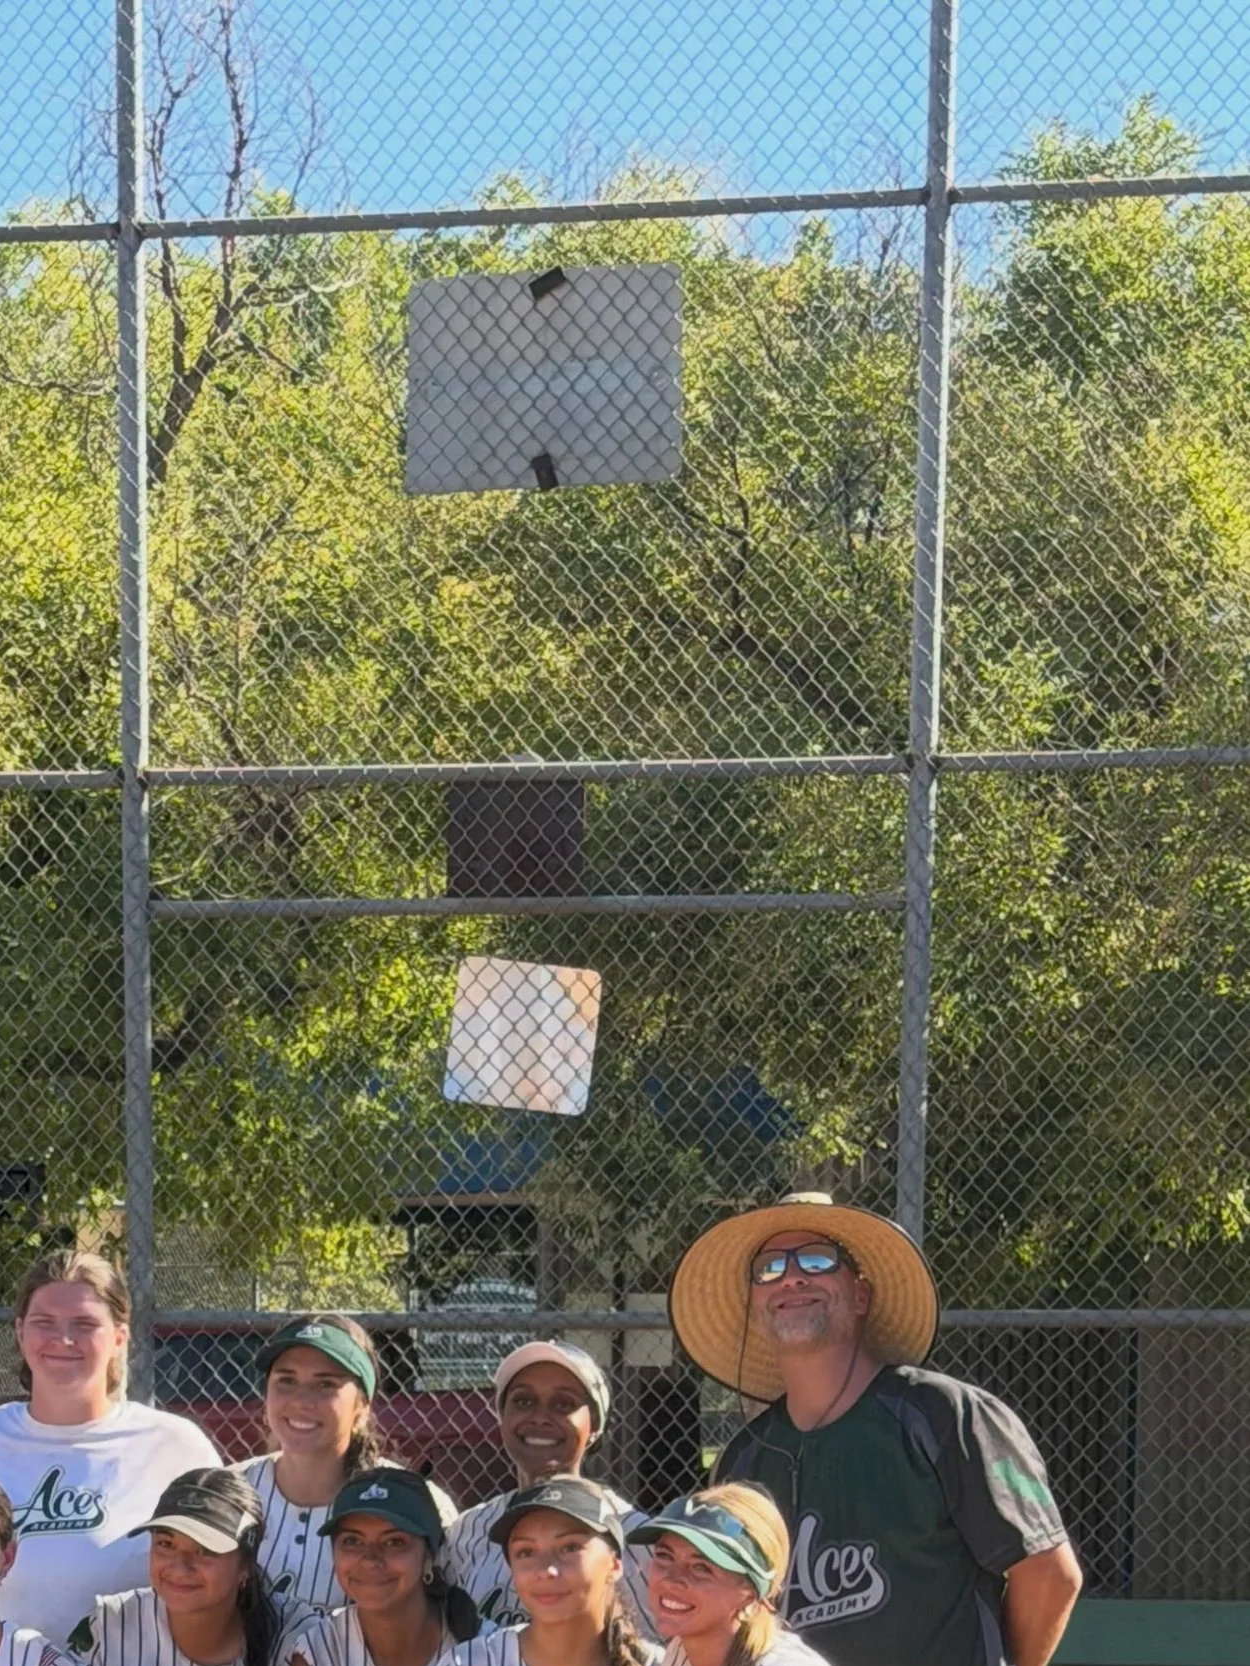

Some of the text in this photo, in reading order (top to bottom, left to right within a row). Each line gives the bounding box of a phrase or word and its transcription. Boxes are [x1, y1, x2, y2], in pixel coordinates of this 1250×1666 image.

[13, 1469, 104, 1530] Aces
[779, 1514, 884, 1618] Aces
[793, 1595, 871, 1622] ACADEMY
